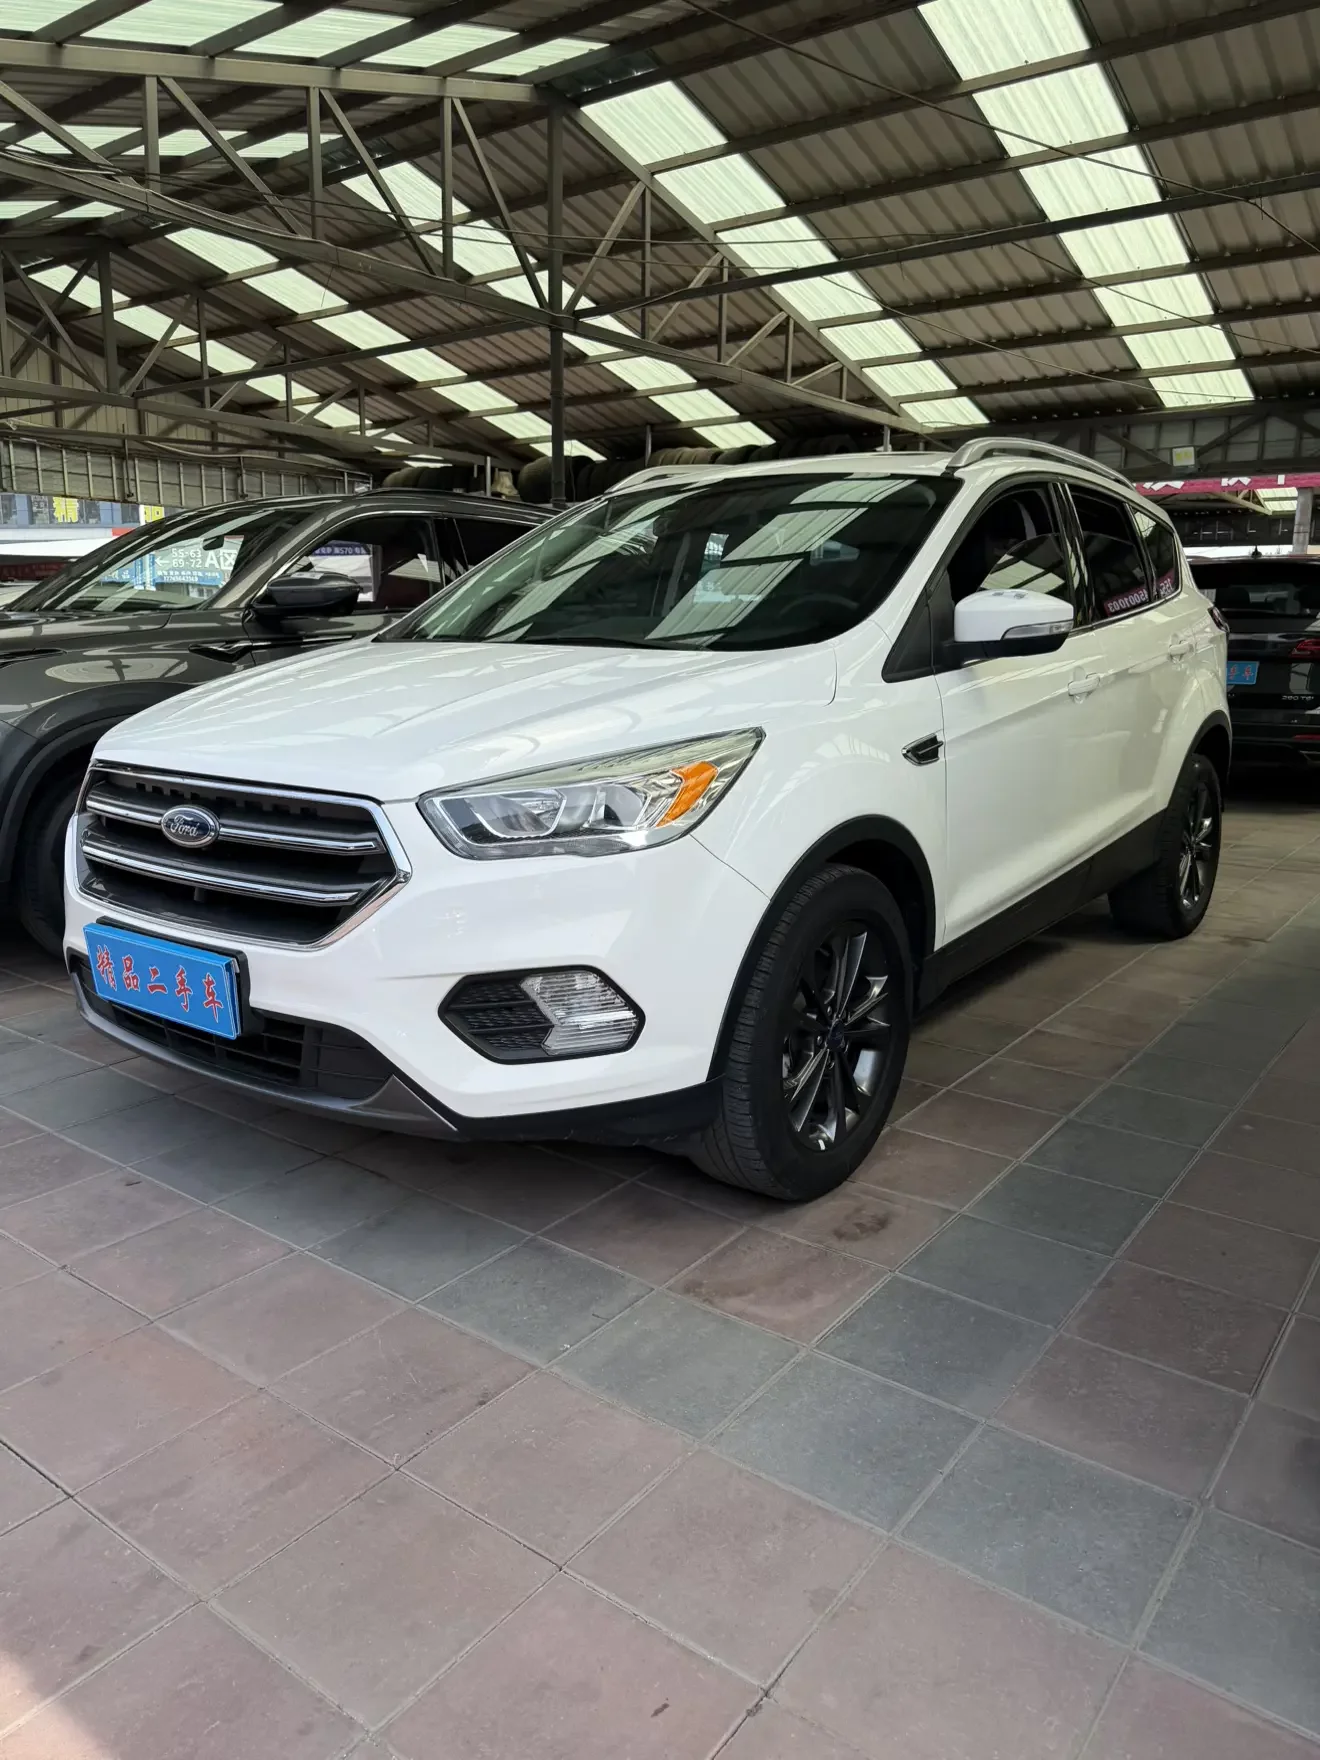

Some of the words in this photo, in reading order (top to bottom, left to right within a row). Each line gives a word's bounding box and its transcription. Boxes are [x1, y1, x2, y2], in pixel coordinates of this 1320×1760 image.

[53, 497, 79, 523] 精
[171, 548, 202, 558] 55-63
[172, 558, 202, 568] 69-72
[204, 549, 239, 570] A区
[169, 814, 200, 837] Ford
[95, 944, 225, 1024] 精品二手车
